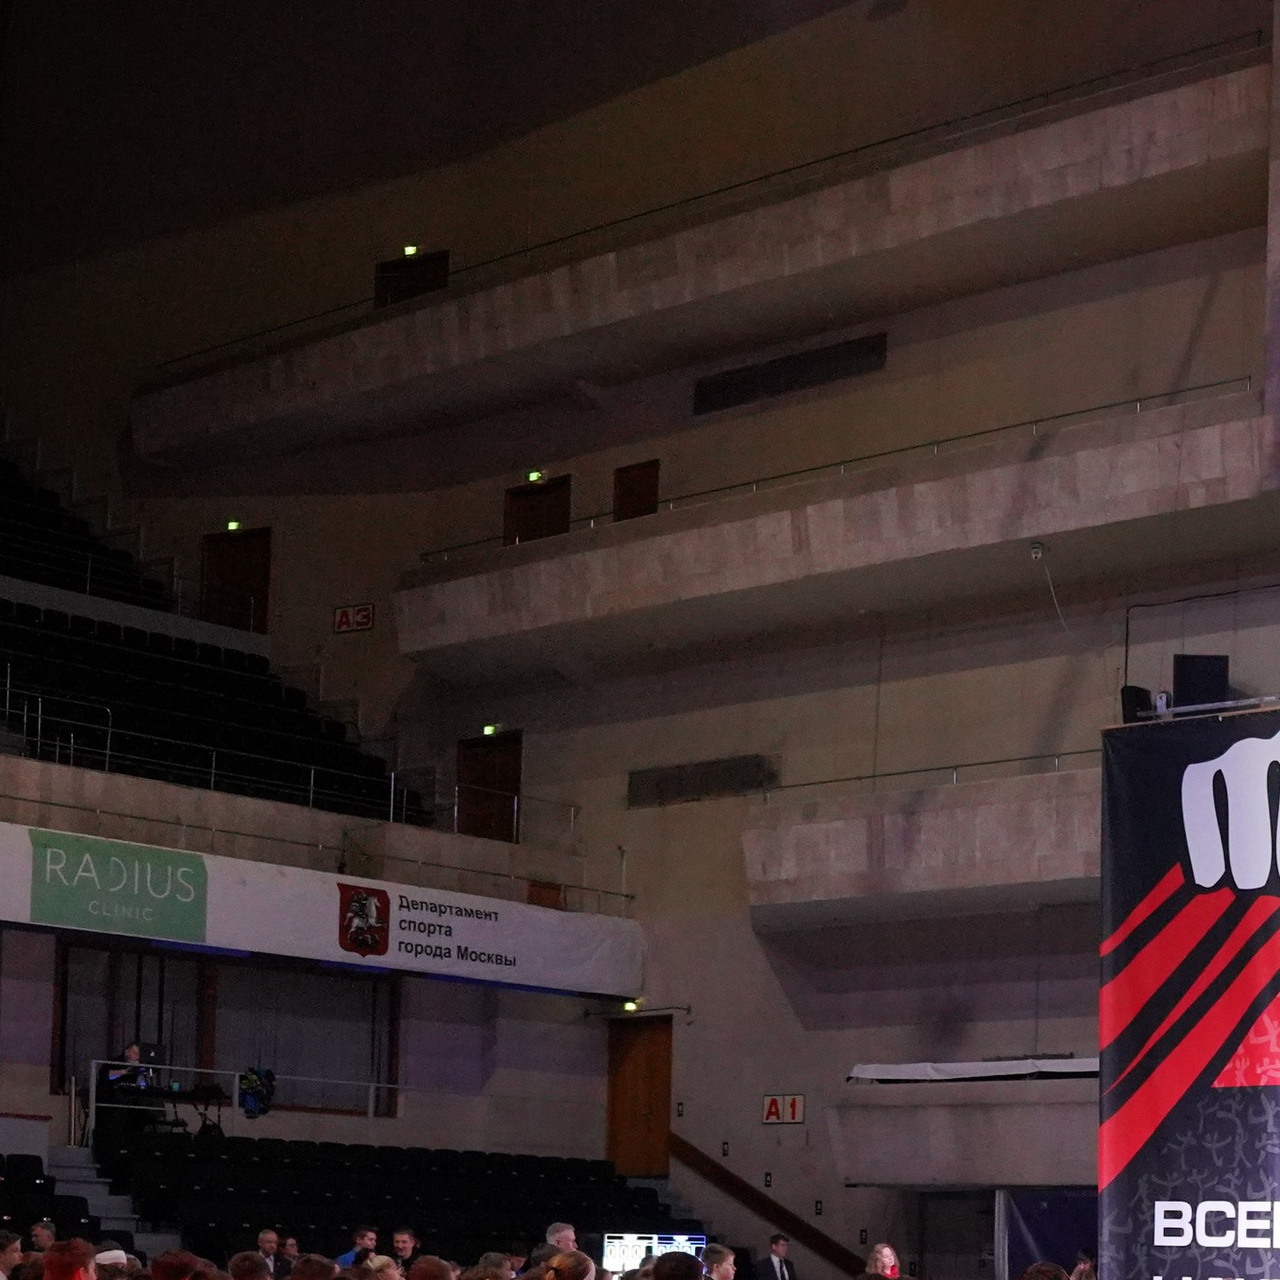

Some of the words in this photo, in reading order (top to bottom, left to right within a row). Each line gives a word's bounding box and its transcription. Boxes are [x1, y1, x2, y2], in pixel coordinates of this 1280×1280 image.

[46, 848, 195, 902] RADIUS
[88, 900, 153, 921] CLINIC
[398, 895, 500, 923] Департамент
[398, 918, 453, 938] спорта
[398, 940, 452, 960] города
[456, 945, 517, 967] Москвы
